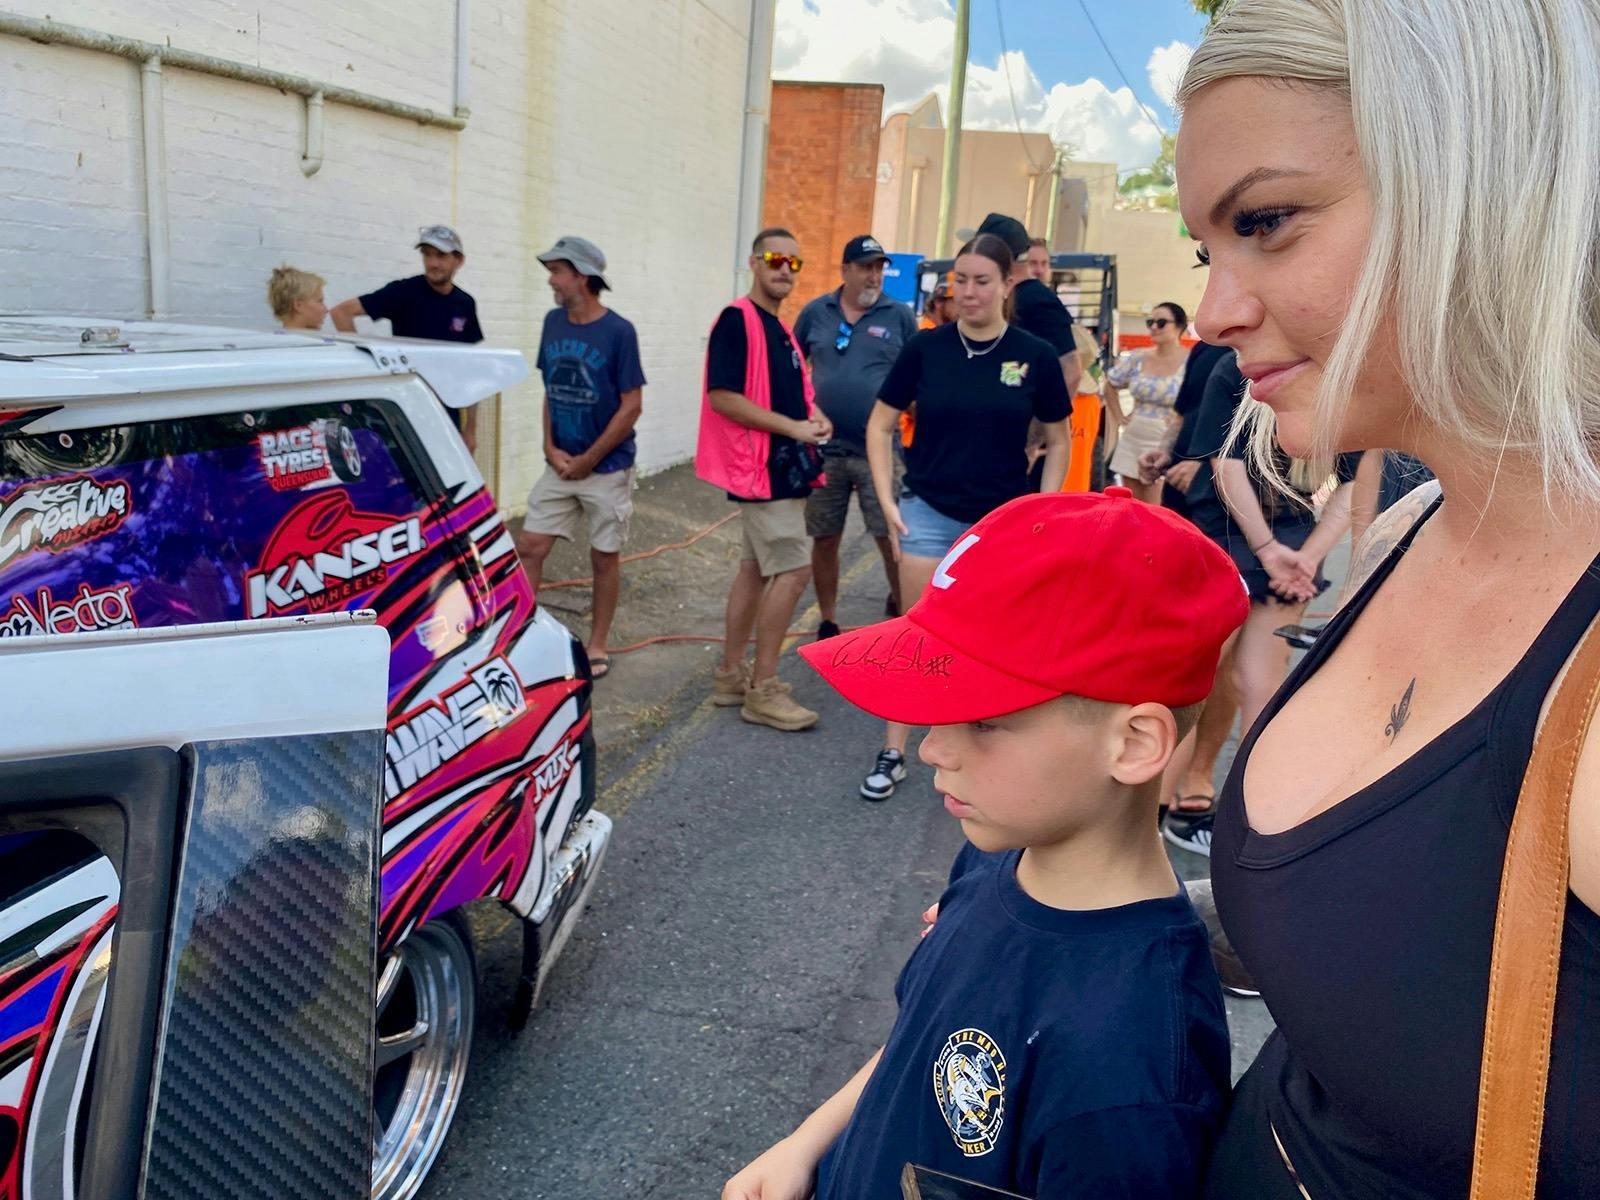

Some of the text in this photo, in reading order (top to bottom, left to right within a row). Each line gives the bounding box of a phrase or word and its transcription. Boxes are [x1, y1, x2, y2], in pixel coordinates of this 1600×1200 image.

[262, 428, 312, 456] RACE
[263, 448, 324, 478] TYRES
[0, 480, 125, 564] Creative
[249, 517, 422, 618] KANSEI
[954, 1031, 998, 1058] THE MAD
